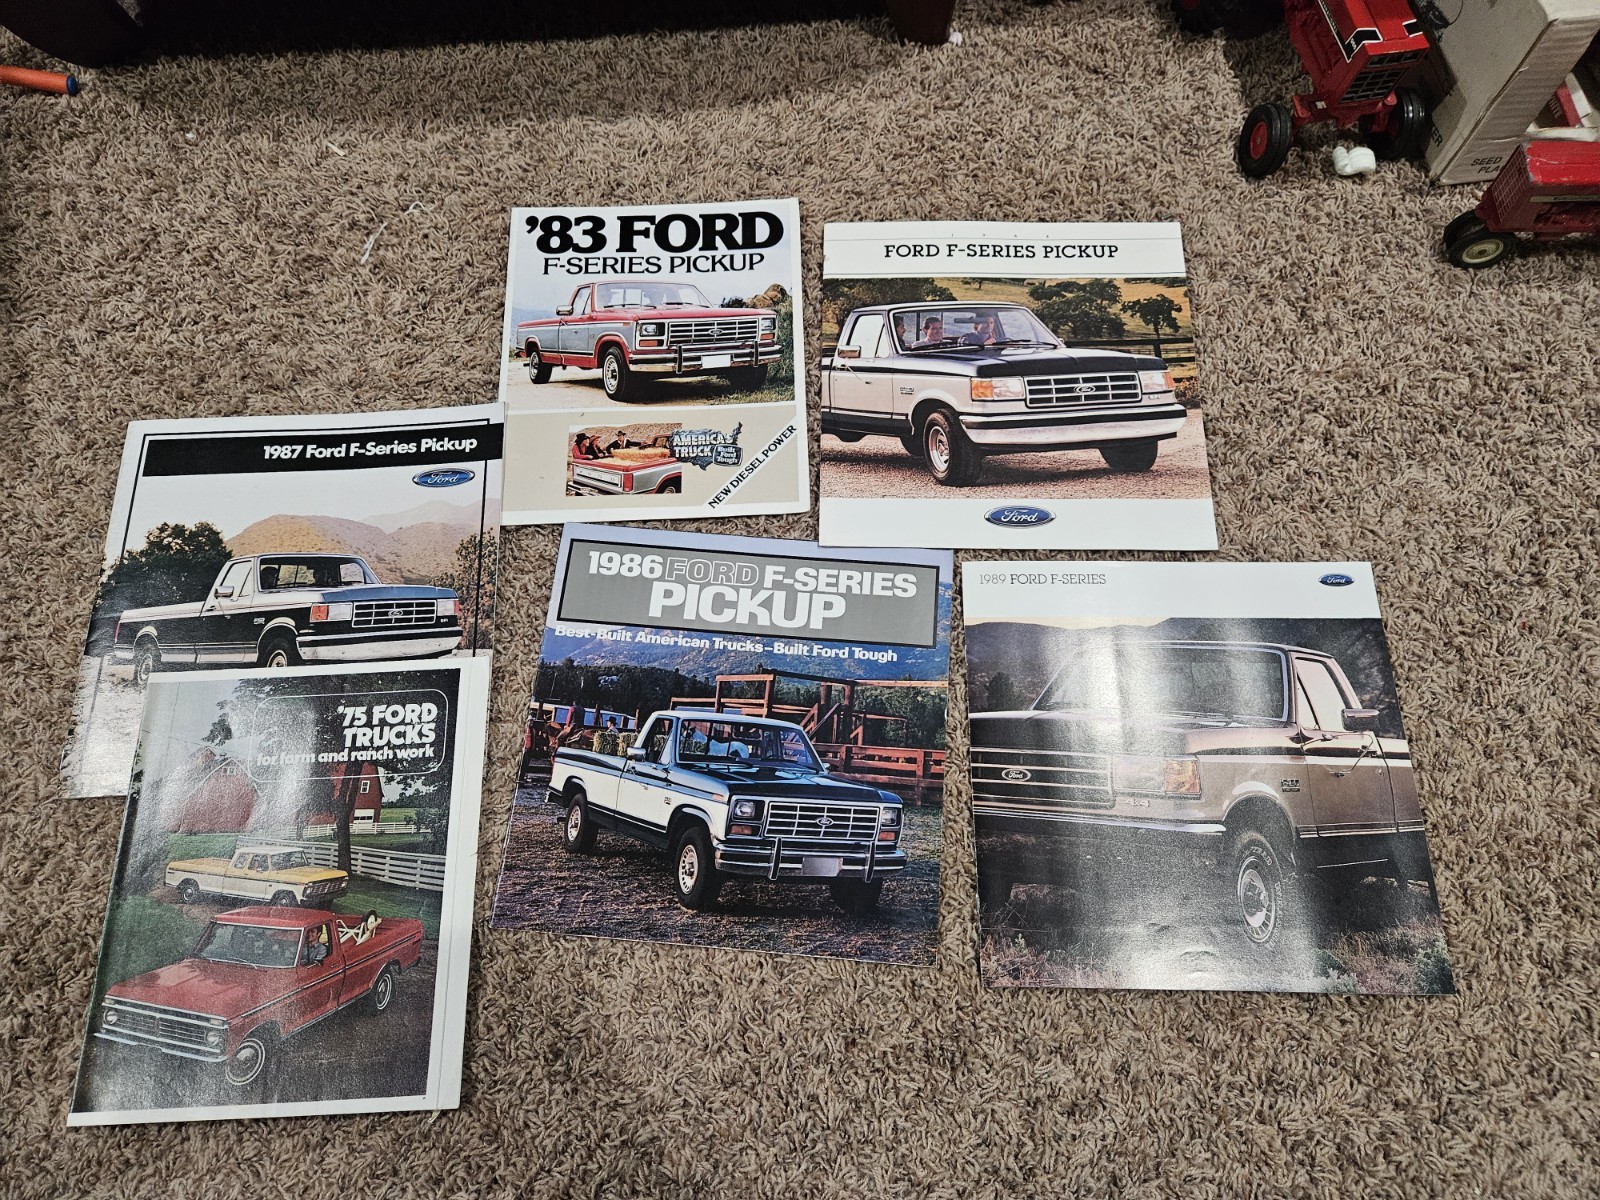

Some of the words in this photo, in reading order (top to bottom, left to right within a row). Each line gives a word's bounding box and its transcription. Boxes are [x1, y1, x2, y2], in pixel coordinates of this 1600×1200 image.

[1471, 156, 1503, 166] SEED
[1477, 166, 1500, 174] PLA
[525, 214, 608, 255] '83
[615, 211, 784, 253] FORD
[884, 243, 941, 259] FORD
[946, 243, 1036, 259] F-SERIES
[1042, 244, 1120, 259] PICKUP
[543, 255, 663, 276] F-SERIES
[668, 252, 765, 274] PICKUP
[263, 444, 303, 460] 1987
[305, 442, 347, 459] Ford
[349, 440, 418, 457] F-Series
[420, 436, 478, 457] Pickup
[674, 444, 713, 458] TRUCK
[707, 485, 732, 509] NEW
[729, 457, 766, 489] DIESEL
[761, 425, 797, 458] POWER
[716, 457, 738, 465] Tough
[427, 471, 460, 484] Ford
[1000, 504, 1039, 522] Ford
[588, 549, 664, 580] 1986
[664, 556, 759, 586] FORD
[763, 564, 918, 599] F-SERIES
[979, 573, 1007, 585] 1989
[1010, 573, 1048, 585] FORD
[1050, 573, 1107, 585] F-SERIES
[648, 581, 847, 630] PICKUP
[554, 624, 633, 643] Best-Built
[634, 629, 711, 649] American
[812, 644, 850, 660] Ford
[852, 646, 898, 663] Tough
[337, 705, 368, 727] '75
[371, 702, 438, 726] FORD
[342, 723, 437, 748] TRUCKS
[256, 753, 277, 766] for
[277, 751, 316, 765] farm
[318, 748, 349, 763] and
[350, 746, 394, 762] ranch
[395, 744, 435, 761] work
